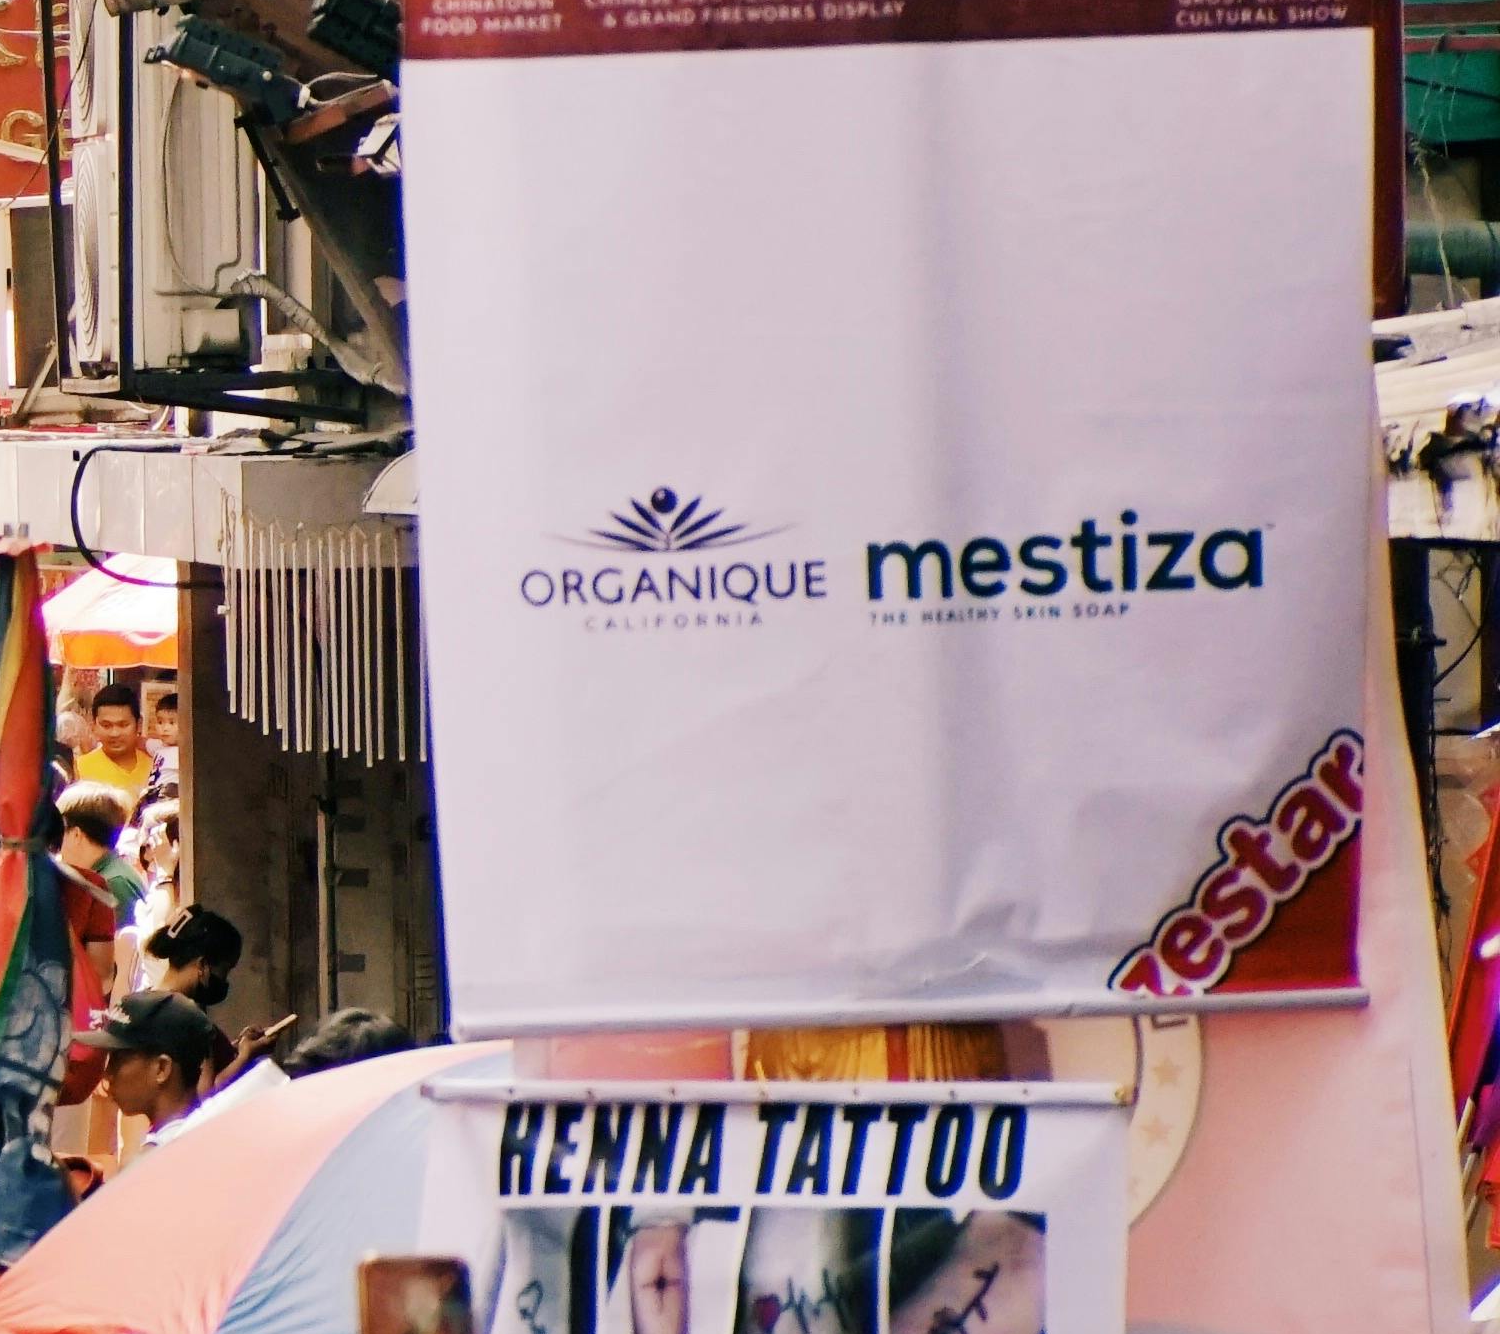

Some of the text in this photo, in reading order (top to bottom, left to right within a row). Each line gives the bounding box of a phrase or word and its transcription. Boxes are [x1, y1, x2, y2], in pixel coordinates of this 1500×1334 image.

[421, 13, 563, 36] FOOD MARKET
[620, 7, 696, 28] GRAND
[702, 3, 816, 24] FIREWORKS
[821, 0, 906, 21] DISPLAY
[1174, 4, 1349, 28] CULTURAL SHOW
[864, 507, 1266, 604] mestiza
[519, 559, 828, 609] ORGANIQUE
[583, 610, 767, 634] CALIFORNIA
[869, 601, 1132, 627] THE HEALTHY SKIN SOAP
[500, 1102, 1030, 1200] HENNA TATTOO
